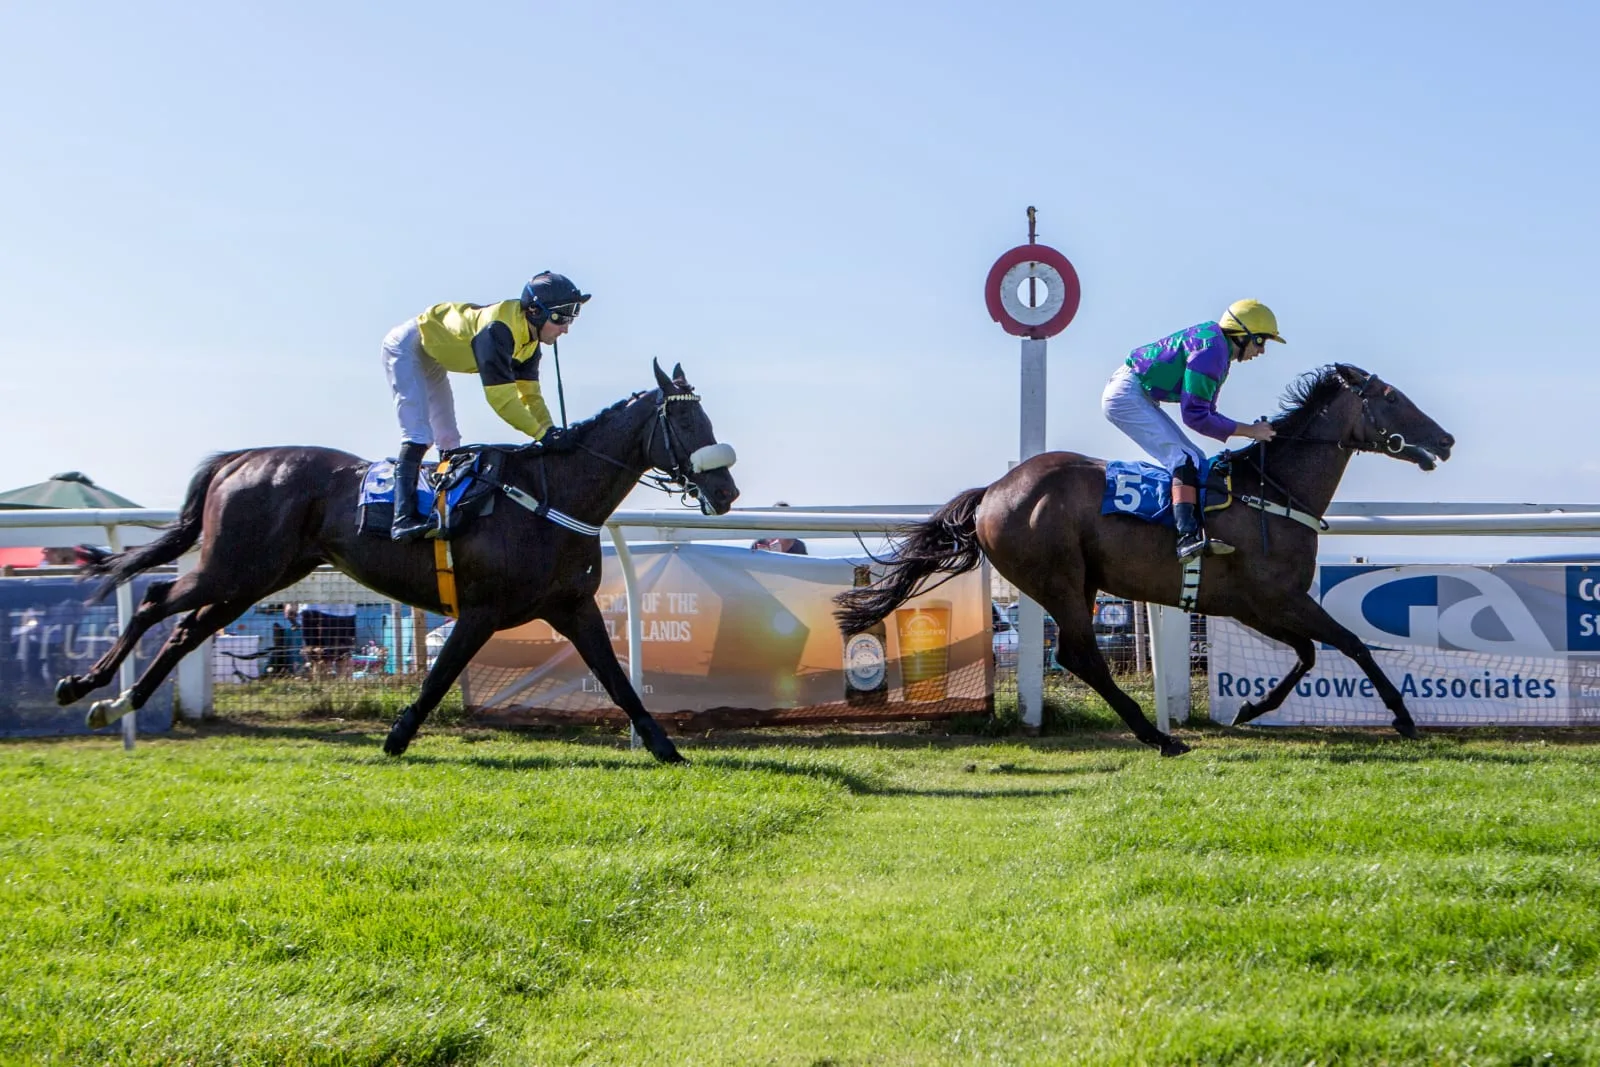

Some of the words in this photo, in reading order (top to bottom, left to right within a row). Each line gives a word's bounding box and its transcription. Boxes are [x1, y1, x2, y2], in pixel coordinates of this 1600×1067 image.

[1113, 474, 1142, 512] 5
[641, 592, 661, 613] OF
[666, 593, 699, 614] THE
[625, 619, 692, 642] ILANDS
[1296, 672, 1375, 698] Gowe
[1401, 671, 1556, 698] Associates
